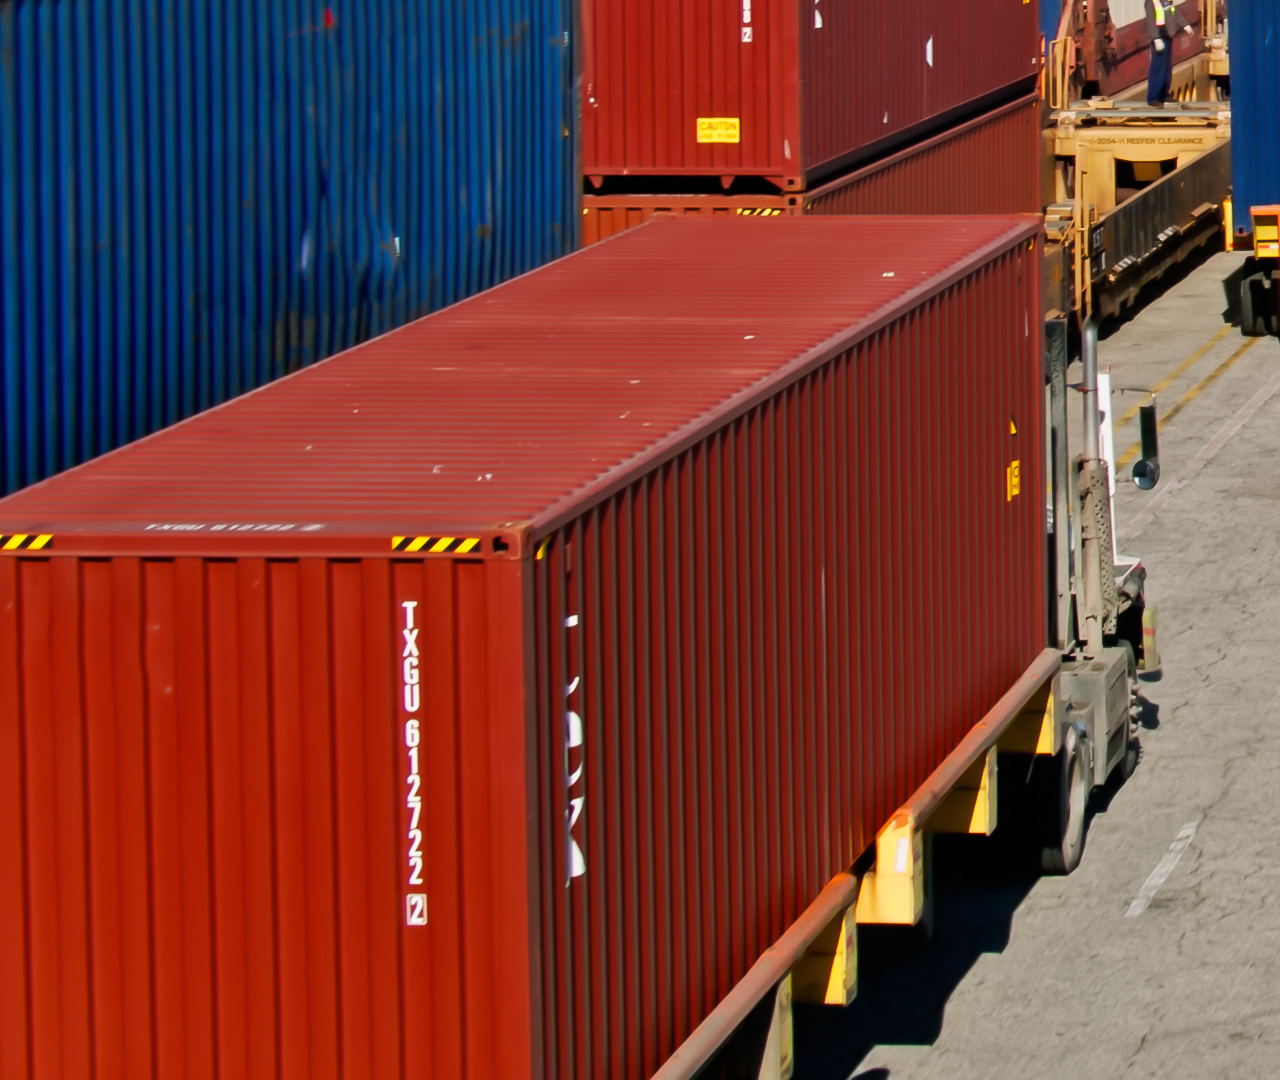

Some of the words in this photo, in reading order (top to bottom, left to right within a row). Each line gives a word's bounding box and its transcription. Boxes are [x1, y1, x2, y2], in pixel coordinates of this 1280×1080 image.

[402, 601, 420, 712] TXGU
[405, 719, 423, 885] 612722
[407, 894, 427, 925] 2
